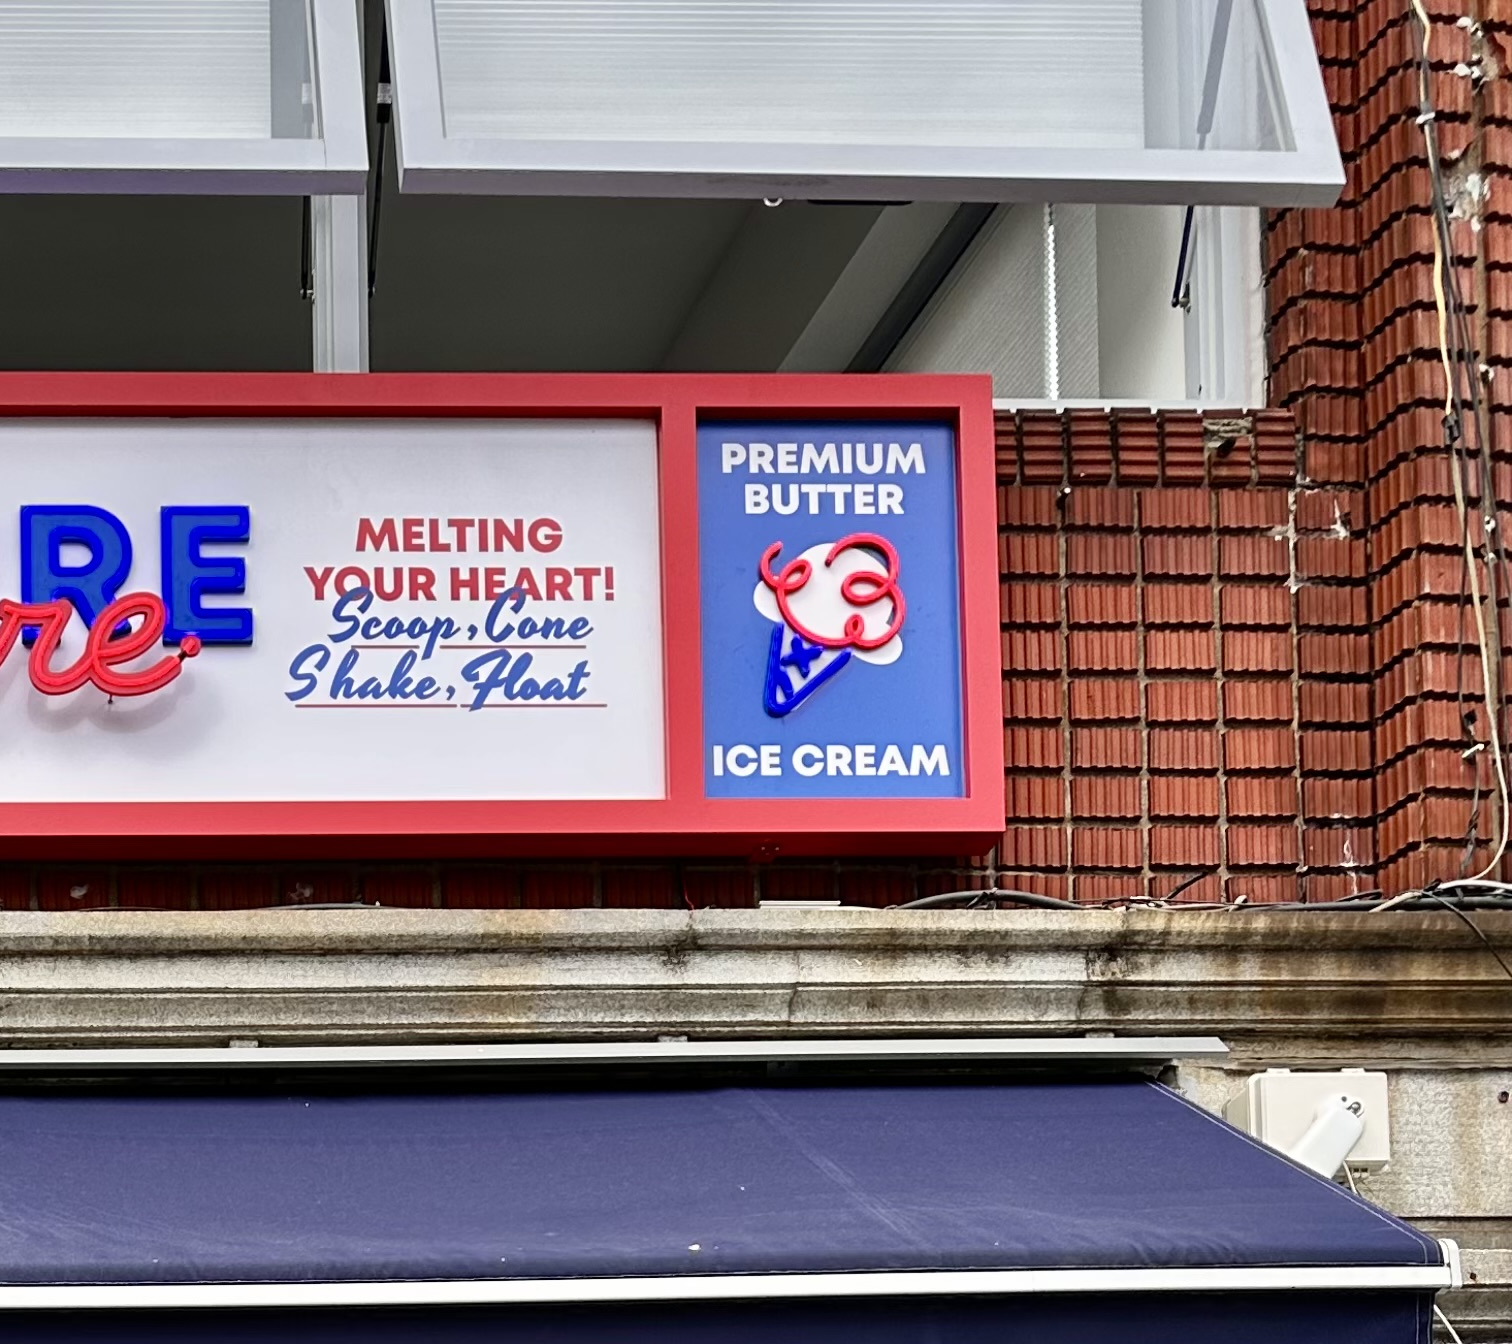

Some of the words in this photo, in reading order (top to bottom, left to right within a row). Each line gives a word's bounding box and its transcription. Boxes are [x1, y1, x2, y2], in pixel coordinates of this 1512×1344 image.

[721, 443, 926, 475] PREMIUM
[745, 483, 904, 515] BUTTER
[355, 518, 563, 552] MELTING
[304, 566, 436, 601] YOUR
[451, 566, 615, 601] HEART!
[712, 744, 782, 776] ICE
[792, 744, 949, 776] CREAM
